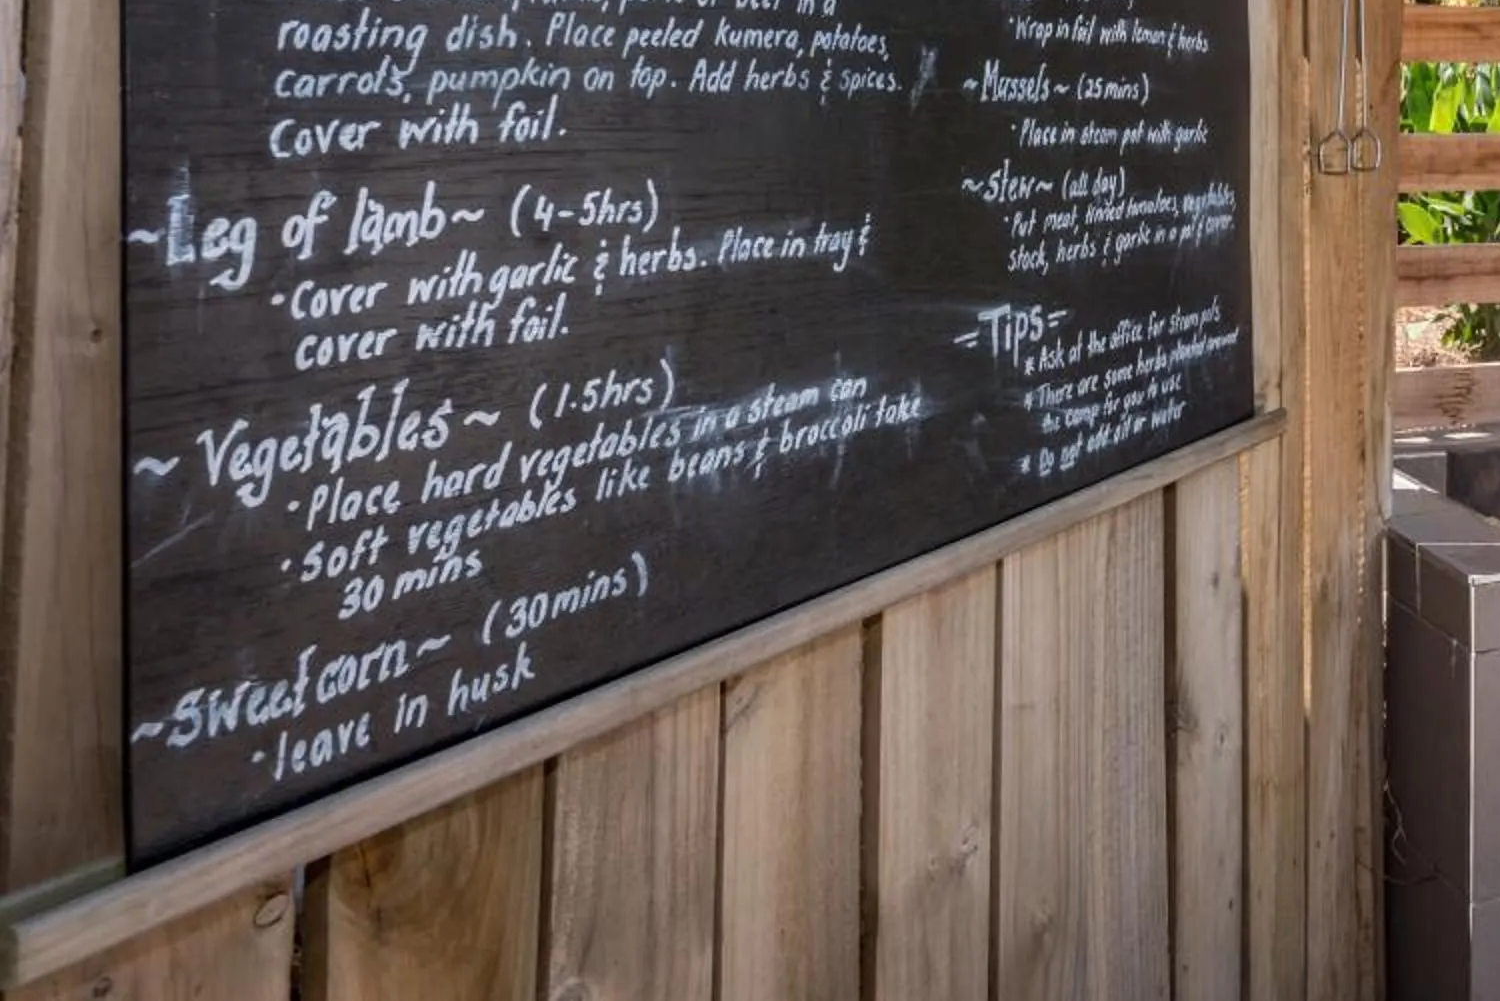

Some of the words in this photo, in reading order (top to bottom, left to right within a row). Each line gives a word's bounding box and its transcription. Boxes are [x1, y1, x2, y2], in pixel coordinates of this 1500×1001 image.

[278, 7, 428, 75] roasting
[447, 15, 532, 49] dish.
[545, 12, 614, 47] Place
[622, 17, 704, 58] peeled
[715, 17, 803, 58] kumera,
[810, 23, 889, 62] potatoes,
[1015, 15, 1053, 47] Wrap
[1071, 13, 1097, 45] foil
[1100, 17, 1127, 47] with
[1131, 17, 1165, 46] lemon
[1177, 23, 1210, 54] herbs
[427, 59, 570, 110] pumpkin
[584, 66, 614, 91] on
[631, 56, 678, 98] top.
[689, 59, 738, 92] Add
[744, 59, 809, 91] herbs
[838, 63, 903, 99] spices.
[980, 58, 1050, 103] Mussels
[400, 102, 478, 149] with
[498, 95, 567, 142] foil.
[1019, 117, 1057, 147] Place
[1060, 120, 1075, 144] in
[1080, 119, 1118, 146] steam
[1119, 119, 1144, 157] pot
[1147, 118, 1172, 144] with
[1175, 117, 1209, 154] garlic
[167, 193, 256, 289] Leg
[282, 189, 337, 260] of
[1010, 207, 1037, 239] Put
[1056, 231, 1098, 263] herbs
[1113, 221, 1151, 266] garlic
[407, 249, 483, 304] with
[490, 241, 578, 307] garlic
[619, 226, 708, 276] herbs.
[718, 226, 773, 264] Place
[780, 230, 805, 258] in
[814, 221, 851, 272] tray
[415, 299, 496, 352] with
[507, 292, 569, 343] foil.
[978, 303, 1044, 367] Tips
[1038, 338, 1066, 372] Ask
[196, 377, 454, 507] Vegetables
[421, 441, 512, 503] hard
[520, 417, 681, 492] vegetables
[693, 406, 717, 441] in
[725, 411, 740, 430] a
[748, 382, 820, 425] steam
[830, 376, 867, 402] can
[407, 478, 577, 563] vegetables
[596, 458, 650, 503] like
[668, 448, 745, 483] beans
[779, 402, 871, 454] broccoli
[875, 393, 922, 429] take
[273, 711, 371, 780] leave
[393, 695, 429, 734] in
[448, 641, 536, 716] husk
